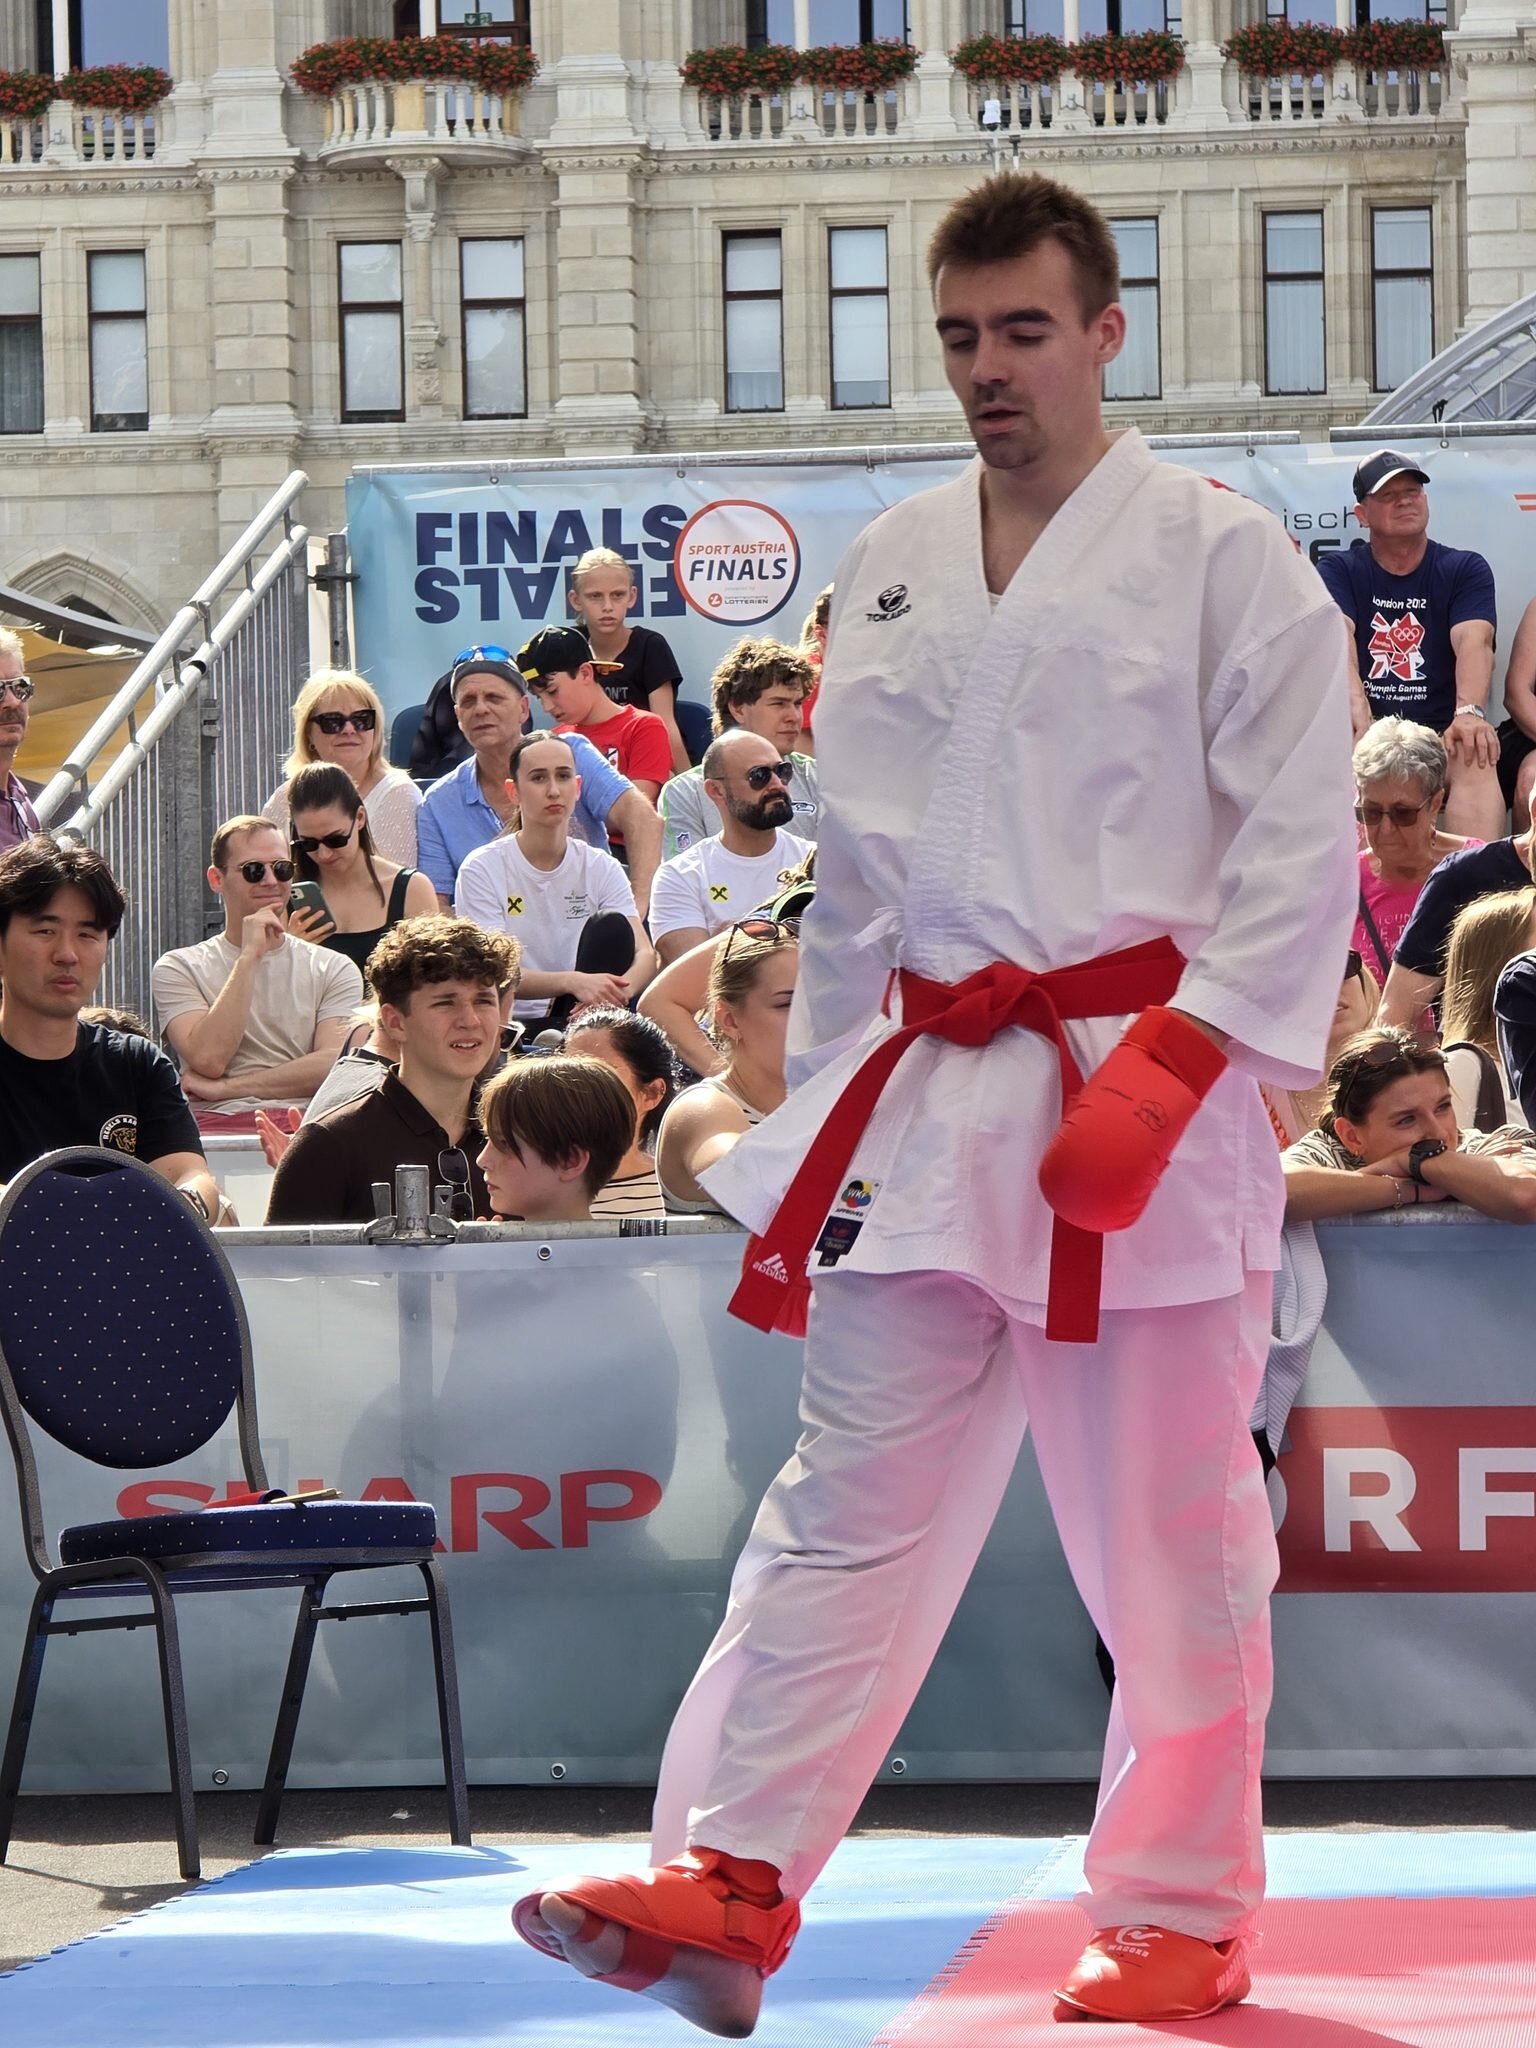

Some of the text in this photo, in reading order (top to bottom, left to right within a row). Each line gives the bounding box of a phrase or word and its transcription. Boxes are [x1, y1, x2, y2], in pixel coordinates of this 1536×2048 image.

[416, 504, 688, 566] FINALS
[688, 541, 787, 555] SPORT AUSTRIA
[689, 557, 788, 581] FINALS
[1372, 594, 1427, 610] London 2012
[1363, 680, 1397, 695] Olympic
[1398, 684, 1428, 693] Games
[1267, 1447, 1536, 1552] RF
